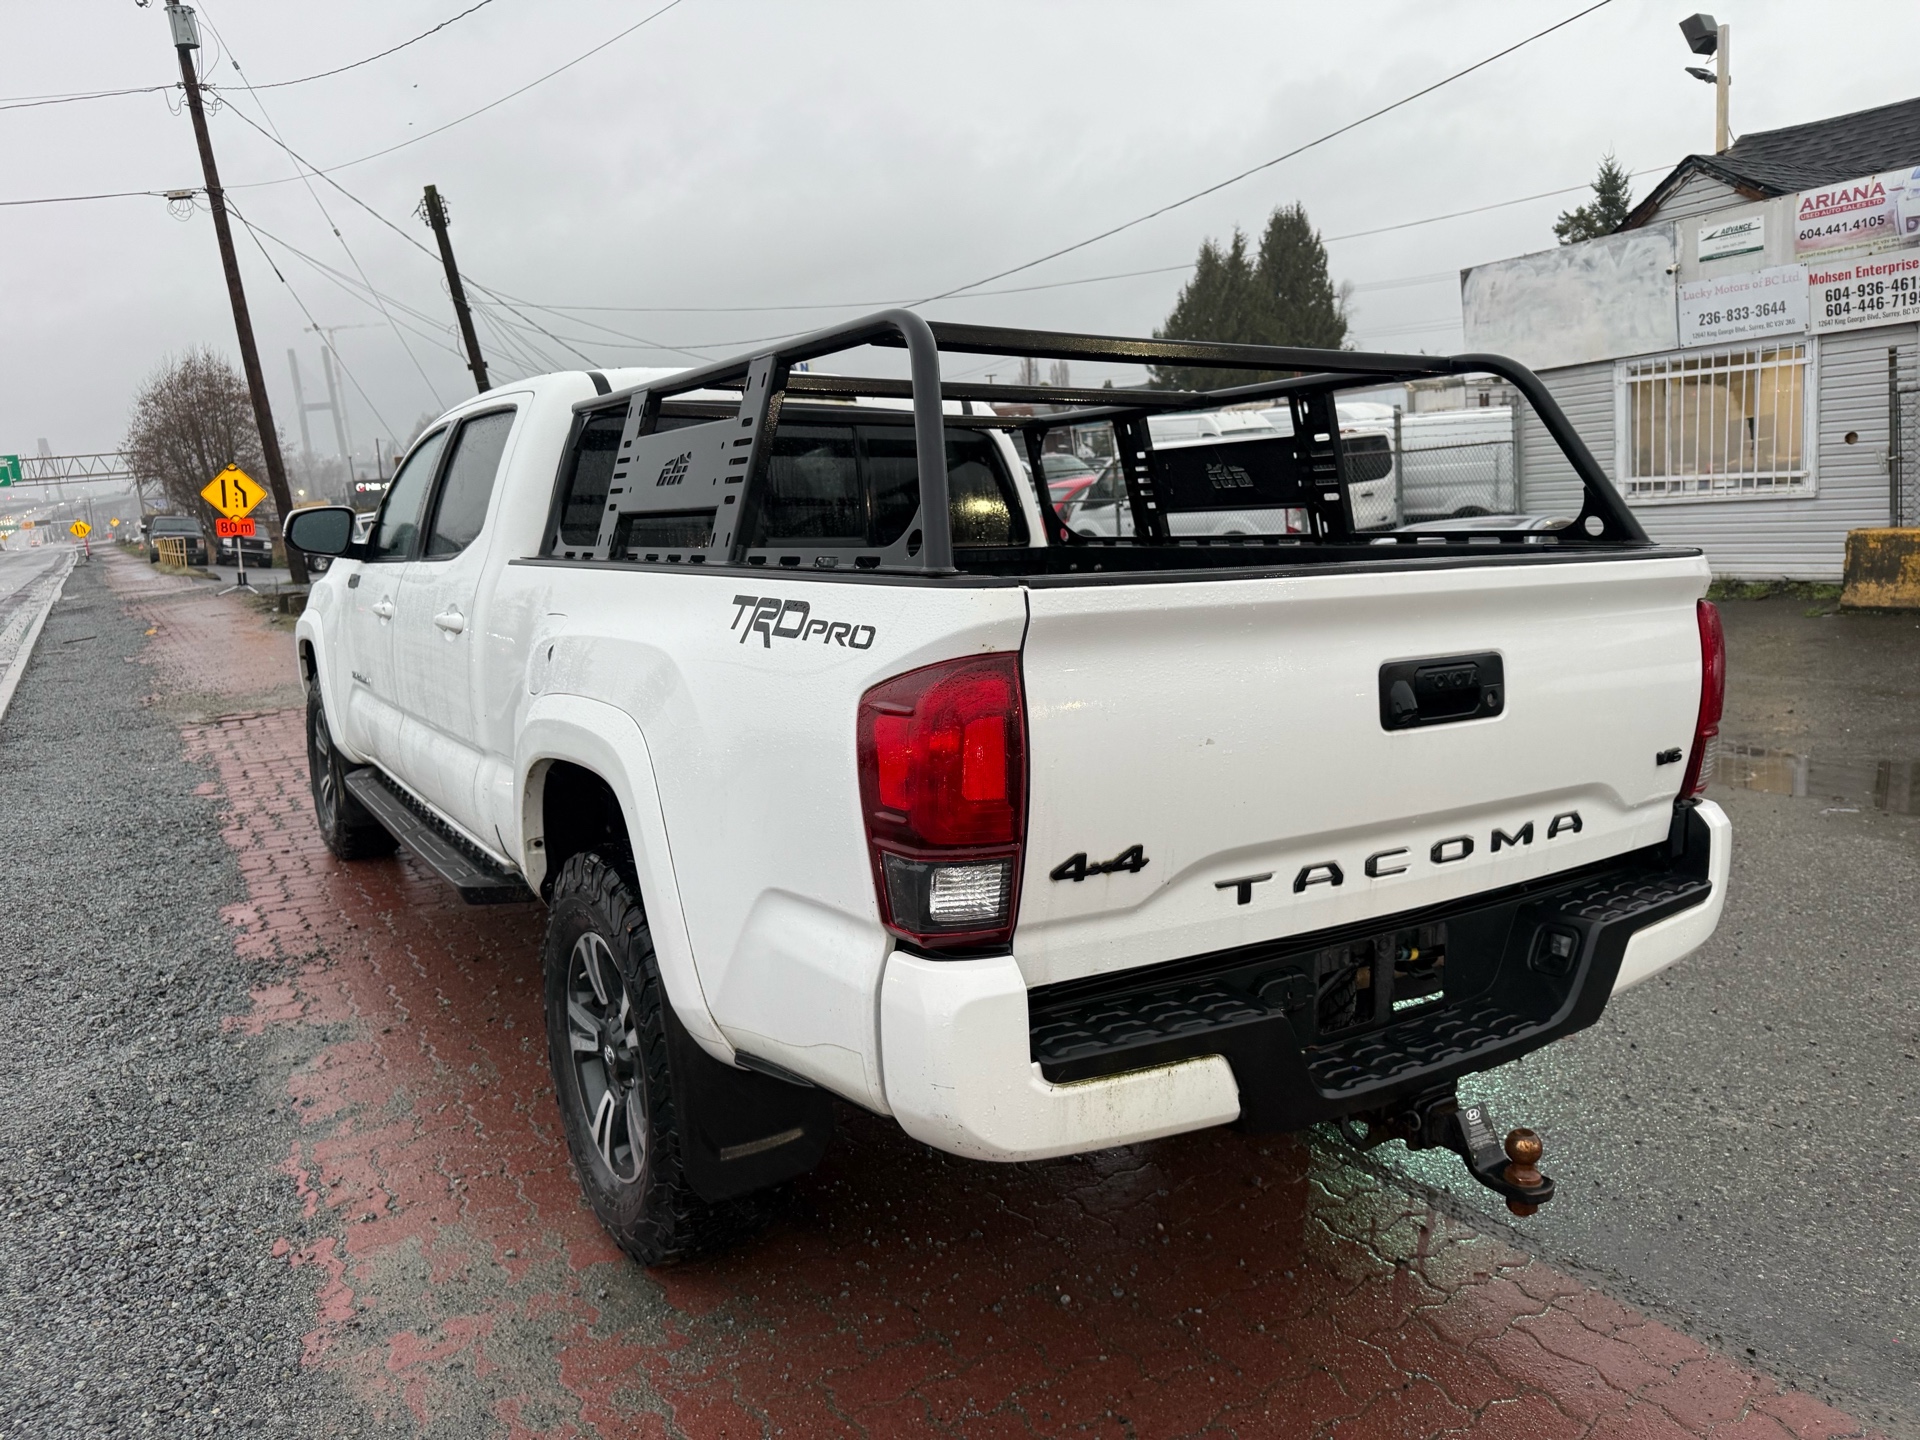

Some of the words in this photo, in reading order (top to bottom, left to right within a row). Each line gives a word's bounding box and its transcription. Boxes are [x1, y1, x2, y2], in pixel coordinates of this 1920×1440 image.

[1799, 182, 1887, 213] ARIANA
[1800, 212, 1820, 220] USED
[1821, 207, 1841, 216] AUTO
[1842, 202, 1867, 212] SALES
[1720, 222, 1752, 235] ADVANCE
[1799, 214, 1885, 241] 604.441.4105
[1809, 270, 1852, 286] Mohsen
[1856, 259, 1919, 279] Enterprise
[1683, 288, 1712, 301] Lucky
[1715, 281, 1750, 296] Motors
[1752, 276, 1764, 288] of
[1764, 275, 1780, 287] BC
[1825, 275, 1920, 303] 604-936-461
[1698, 300, 1787, 327] 236-833-3644
[1834, 317, 1846, 326] King
[1847, 315, 1866, 324] George
[1902, 308, 1911, 316] BC
[1706, 328, 1717, 338] King
[1718, 327, 1734, 337] George
[1766, 320, 1774, 329] BC
[220, 522, 238, 533] 80
[240, 523, 252, 534] m
[730, 594, 811, 649] TRD
[801, 619, 876, 650] PRO
[1656, 747, 1682, 766] V6
[1213, 811, 1583, 906] TACOMA
